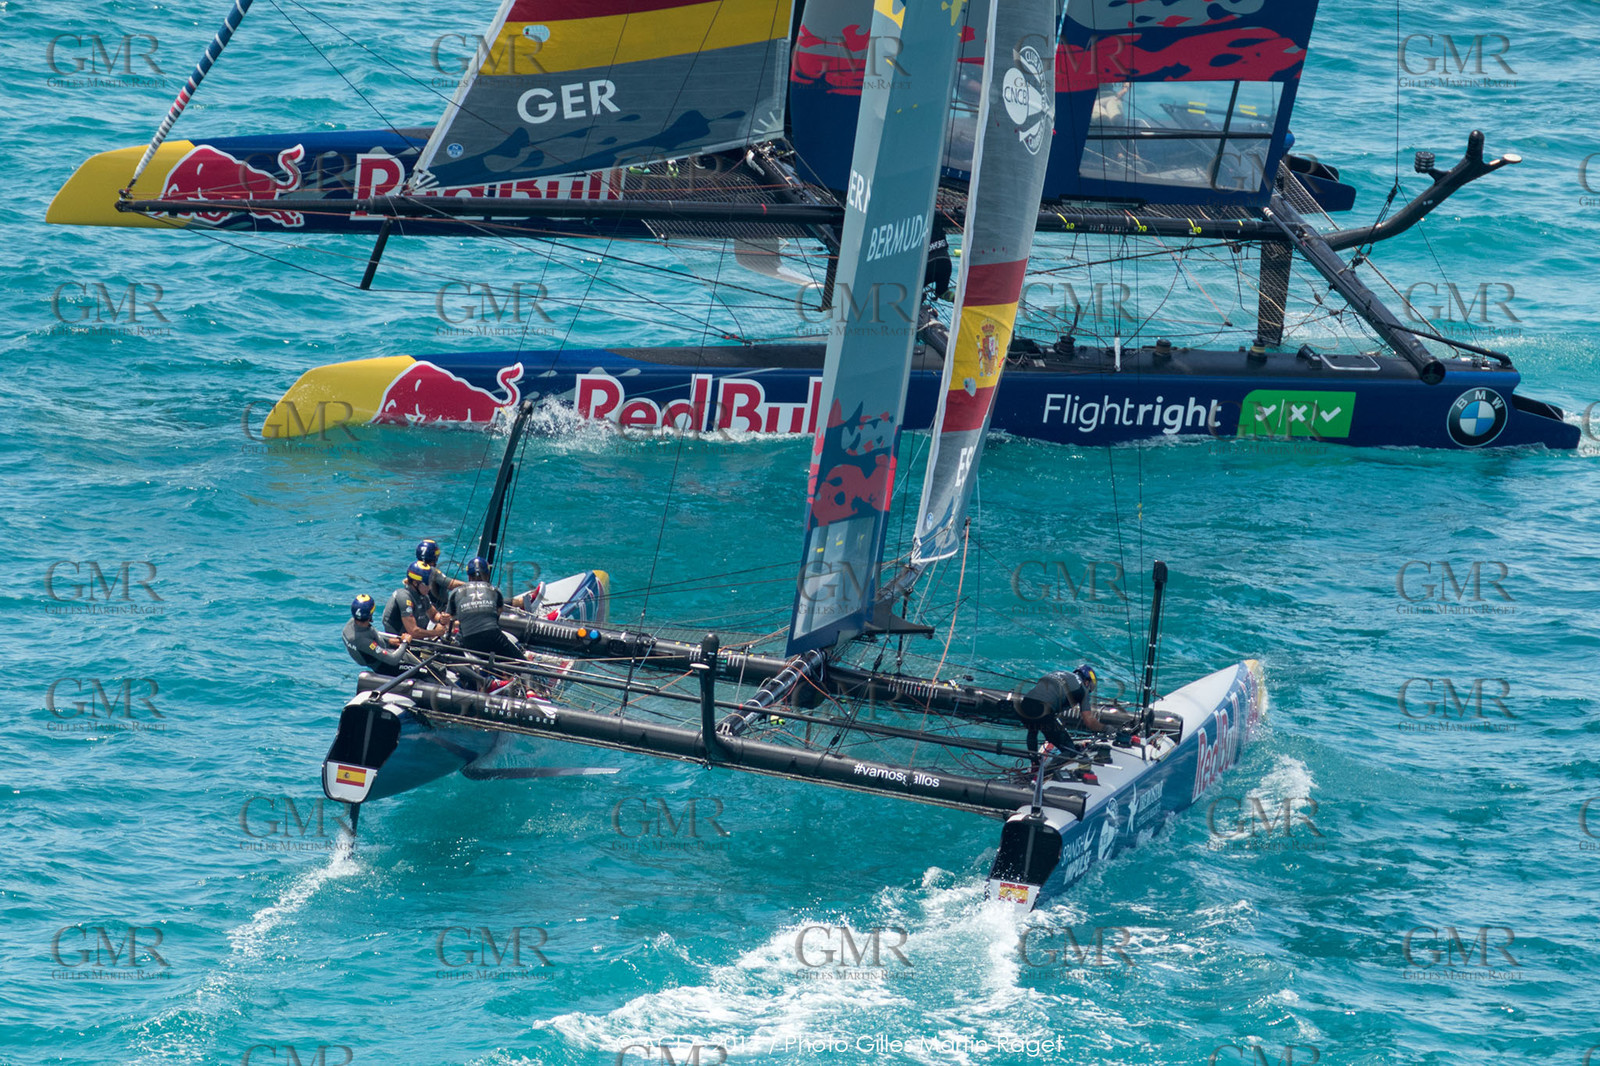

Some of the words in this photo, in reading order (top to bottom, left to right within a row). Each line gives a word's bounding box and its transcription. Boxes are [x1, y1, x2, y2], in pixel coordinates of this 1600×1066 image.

[517, 79, 621, 124] GER
[867, 210, 929, 262] BERMUDA
[575, 373, 713, 432] Red
[718, 376, 823, 433] Bul
[1042, 394, 1222, 434] Flightright
[1456, 390, 1503, 410] BMW
